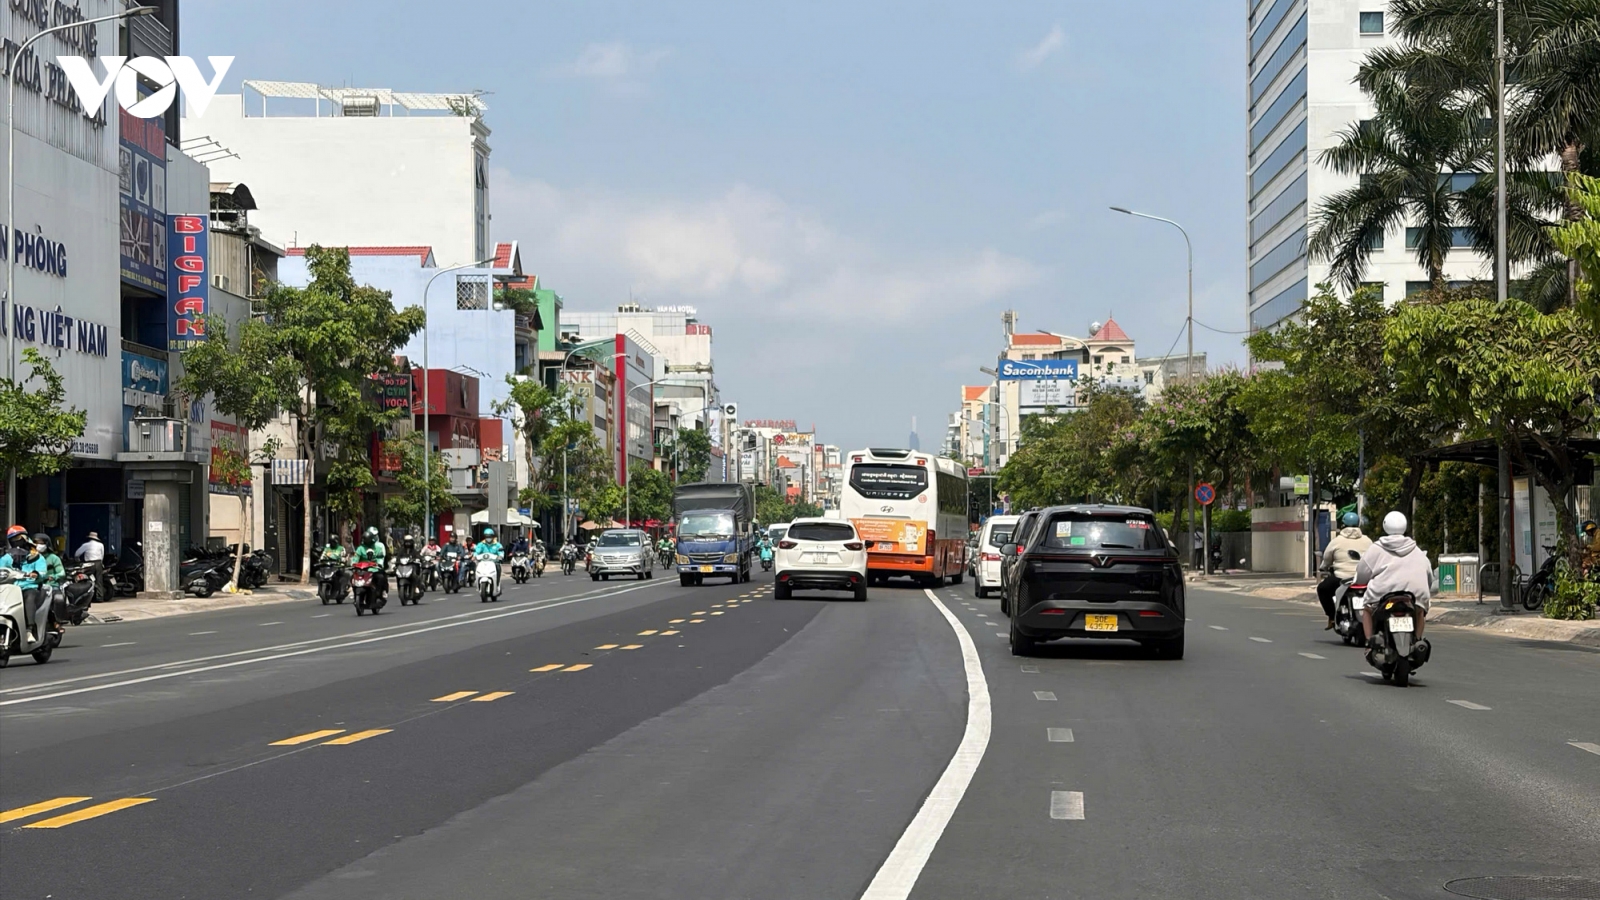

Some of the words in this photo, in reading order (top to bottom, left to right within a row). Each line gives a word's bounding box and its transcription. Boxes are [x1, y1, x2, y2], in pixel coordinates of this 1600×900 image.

[14, 223, 67, 278] PHÒNG
[174, 216, 205, 335] BIGFAN
[39, 303, 74, 358] VIỆT
[76, 319, 108, 358] NAM
[1002, 363, 1075, 377] Sacombank
[385, 398, 409, 408] YOGA
[386, 387, 407, 397] GYM
[191, 400, 206, 424] SKY
